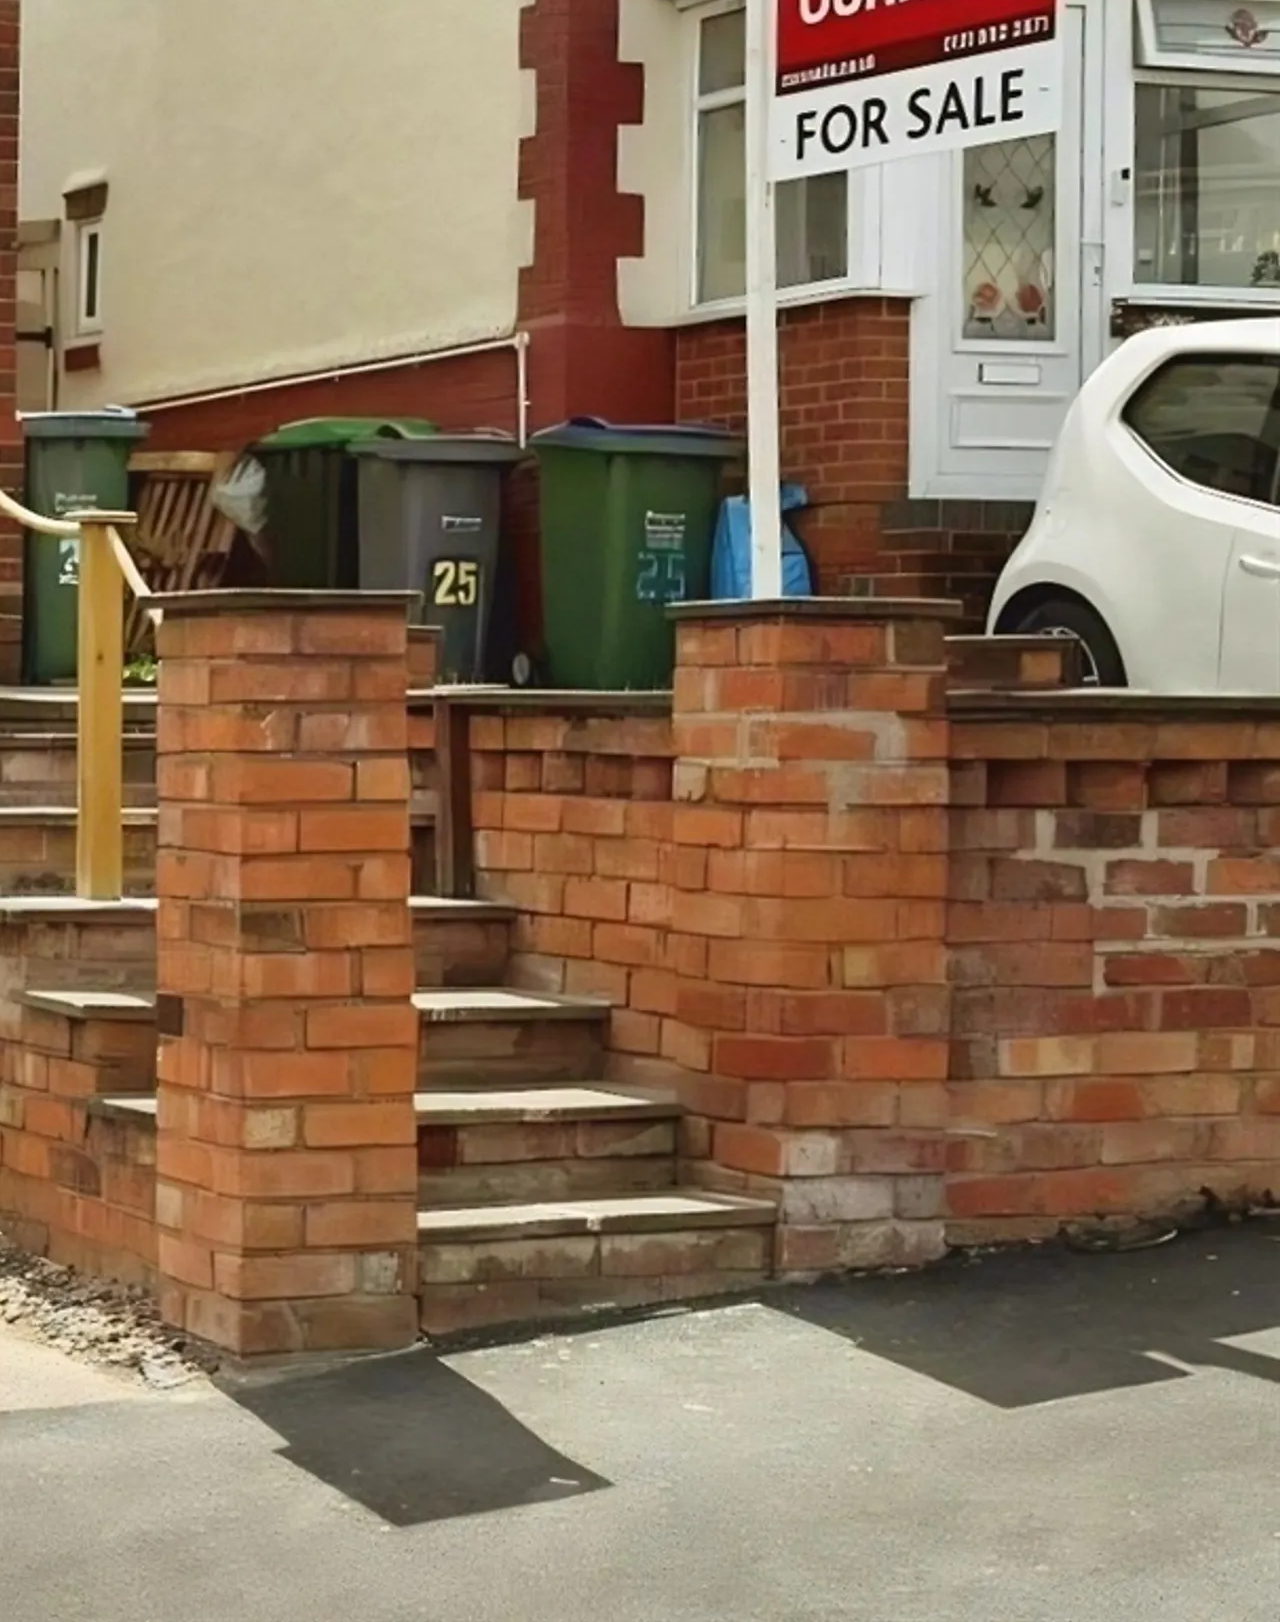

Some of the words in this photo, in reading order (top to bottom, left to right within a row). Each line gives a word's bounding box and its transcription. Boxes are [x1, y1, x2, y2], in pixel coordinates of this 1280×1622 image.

[795, 97, 890, 160] FOR
[906, 69, 1025, 139] SALE
[434, 560, 477, 606] 25
[636, 551, 686, 600] 25
